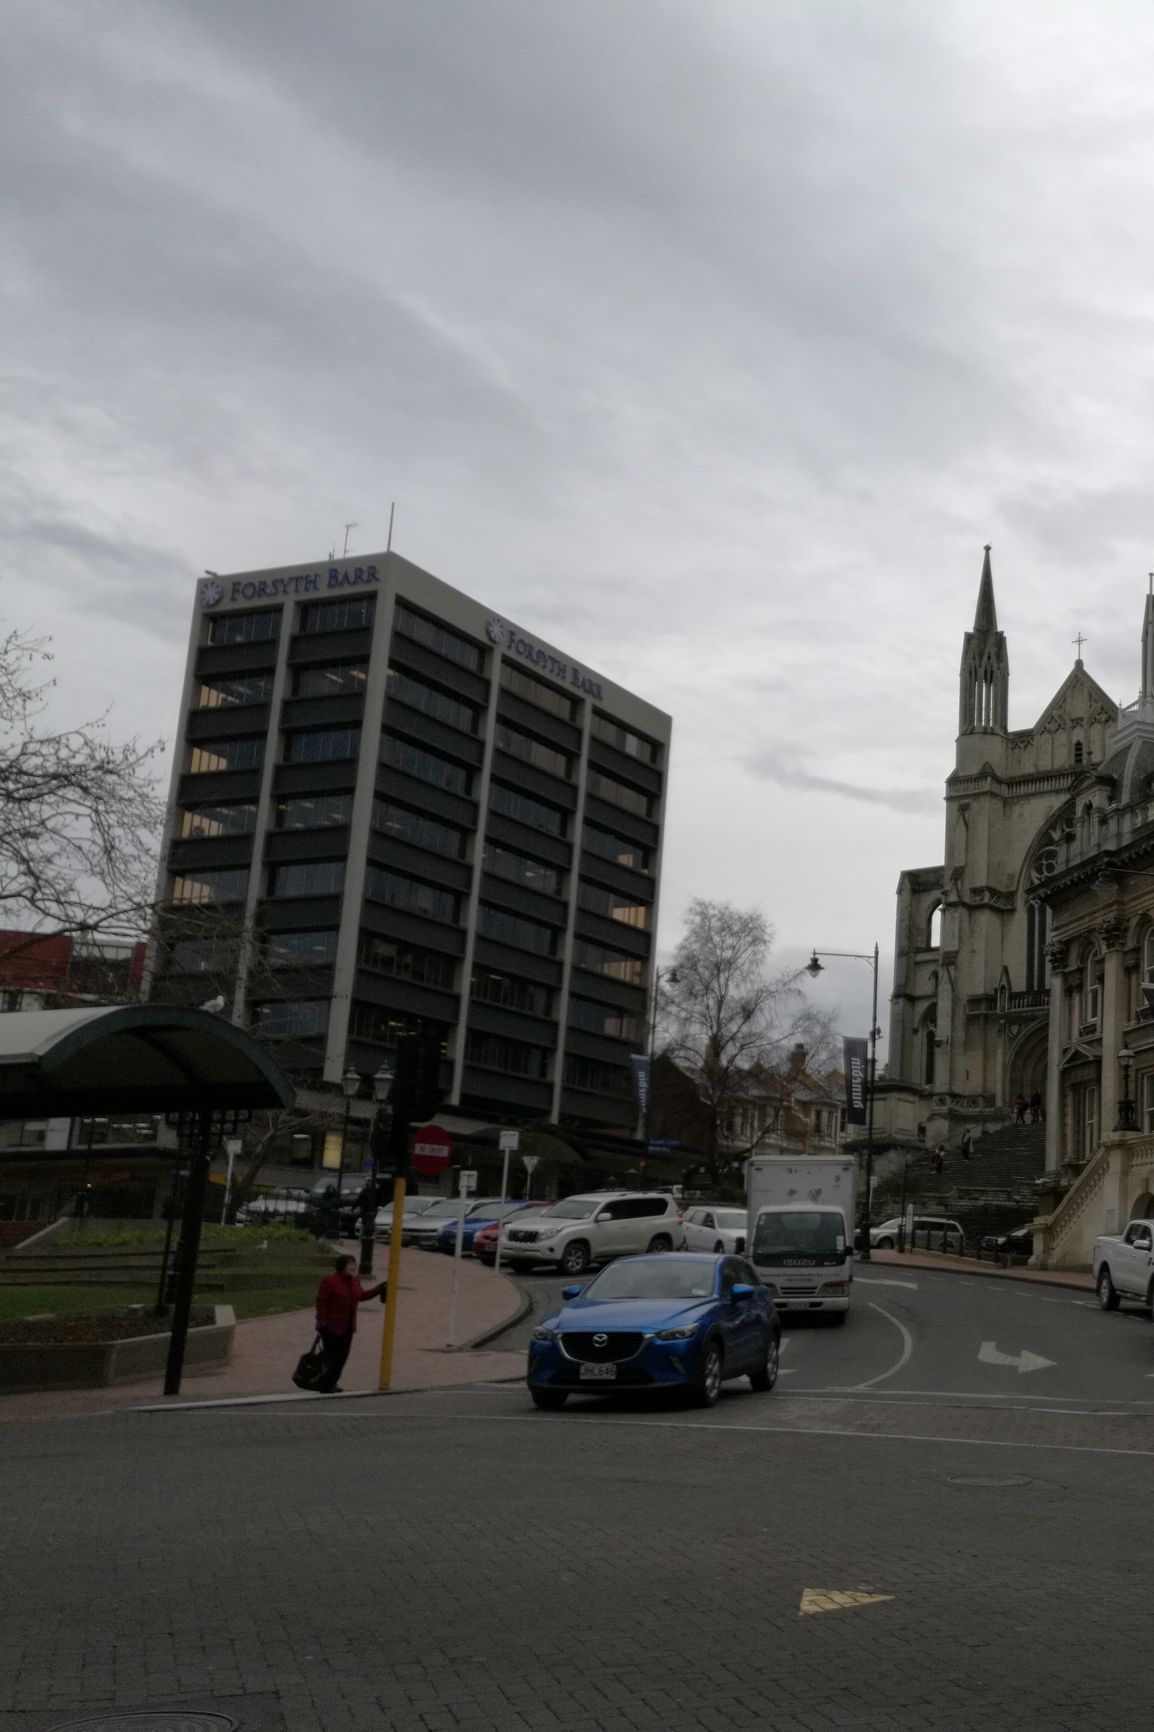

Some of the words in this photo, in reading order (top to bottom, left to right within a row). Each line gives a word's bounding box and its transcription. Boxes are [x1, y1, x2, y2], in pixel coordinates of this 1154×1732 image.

[230, 573, 320, 601] FORSYTH
[326, 565, 381, 589] BARR
[783, 1258, 816, 1266] ISUZU
